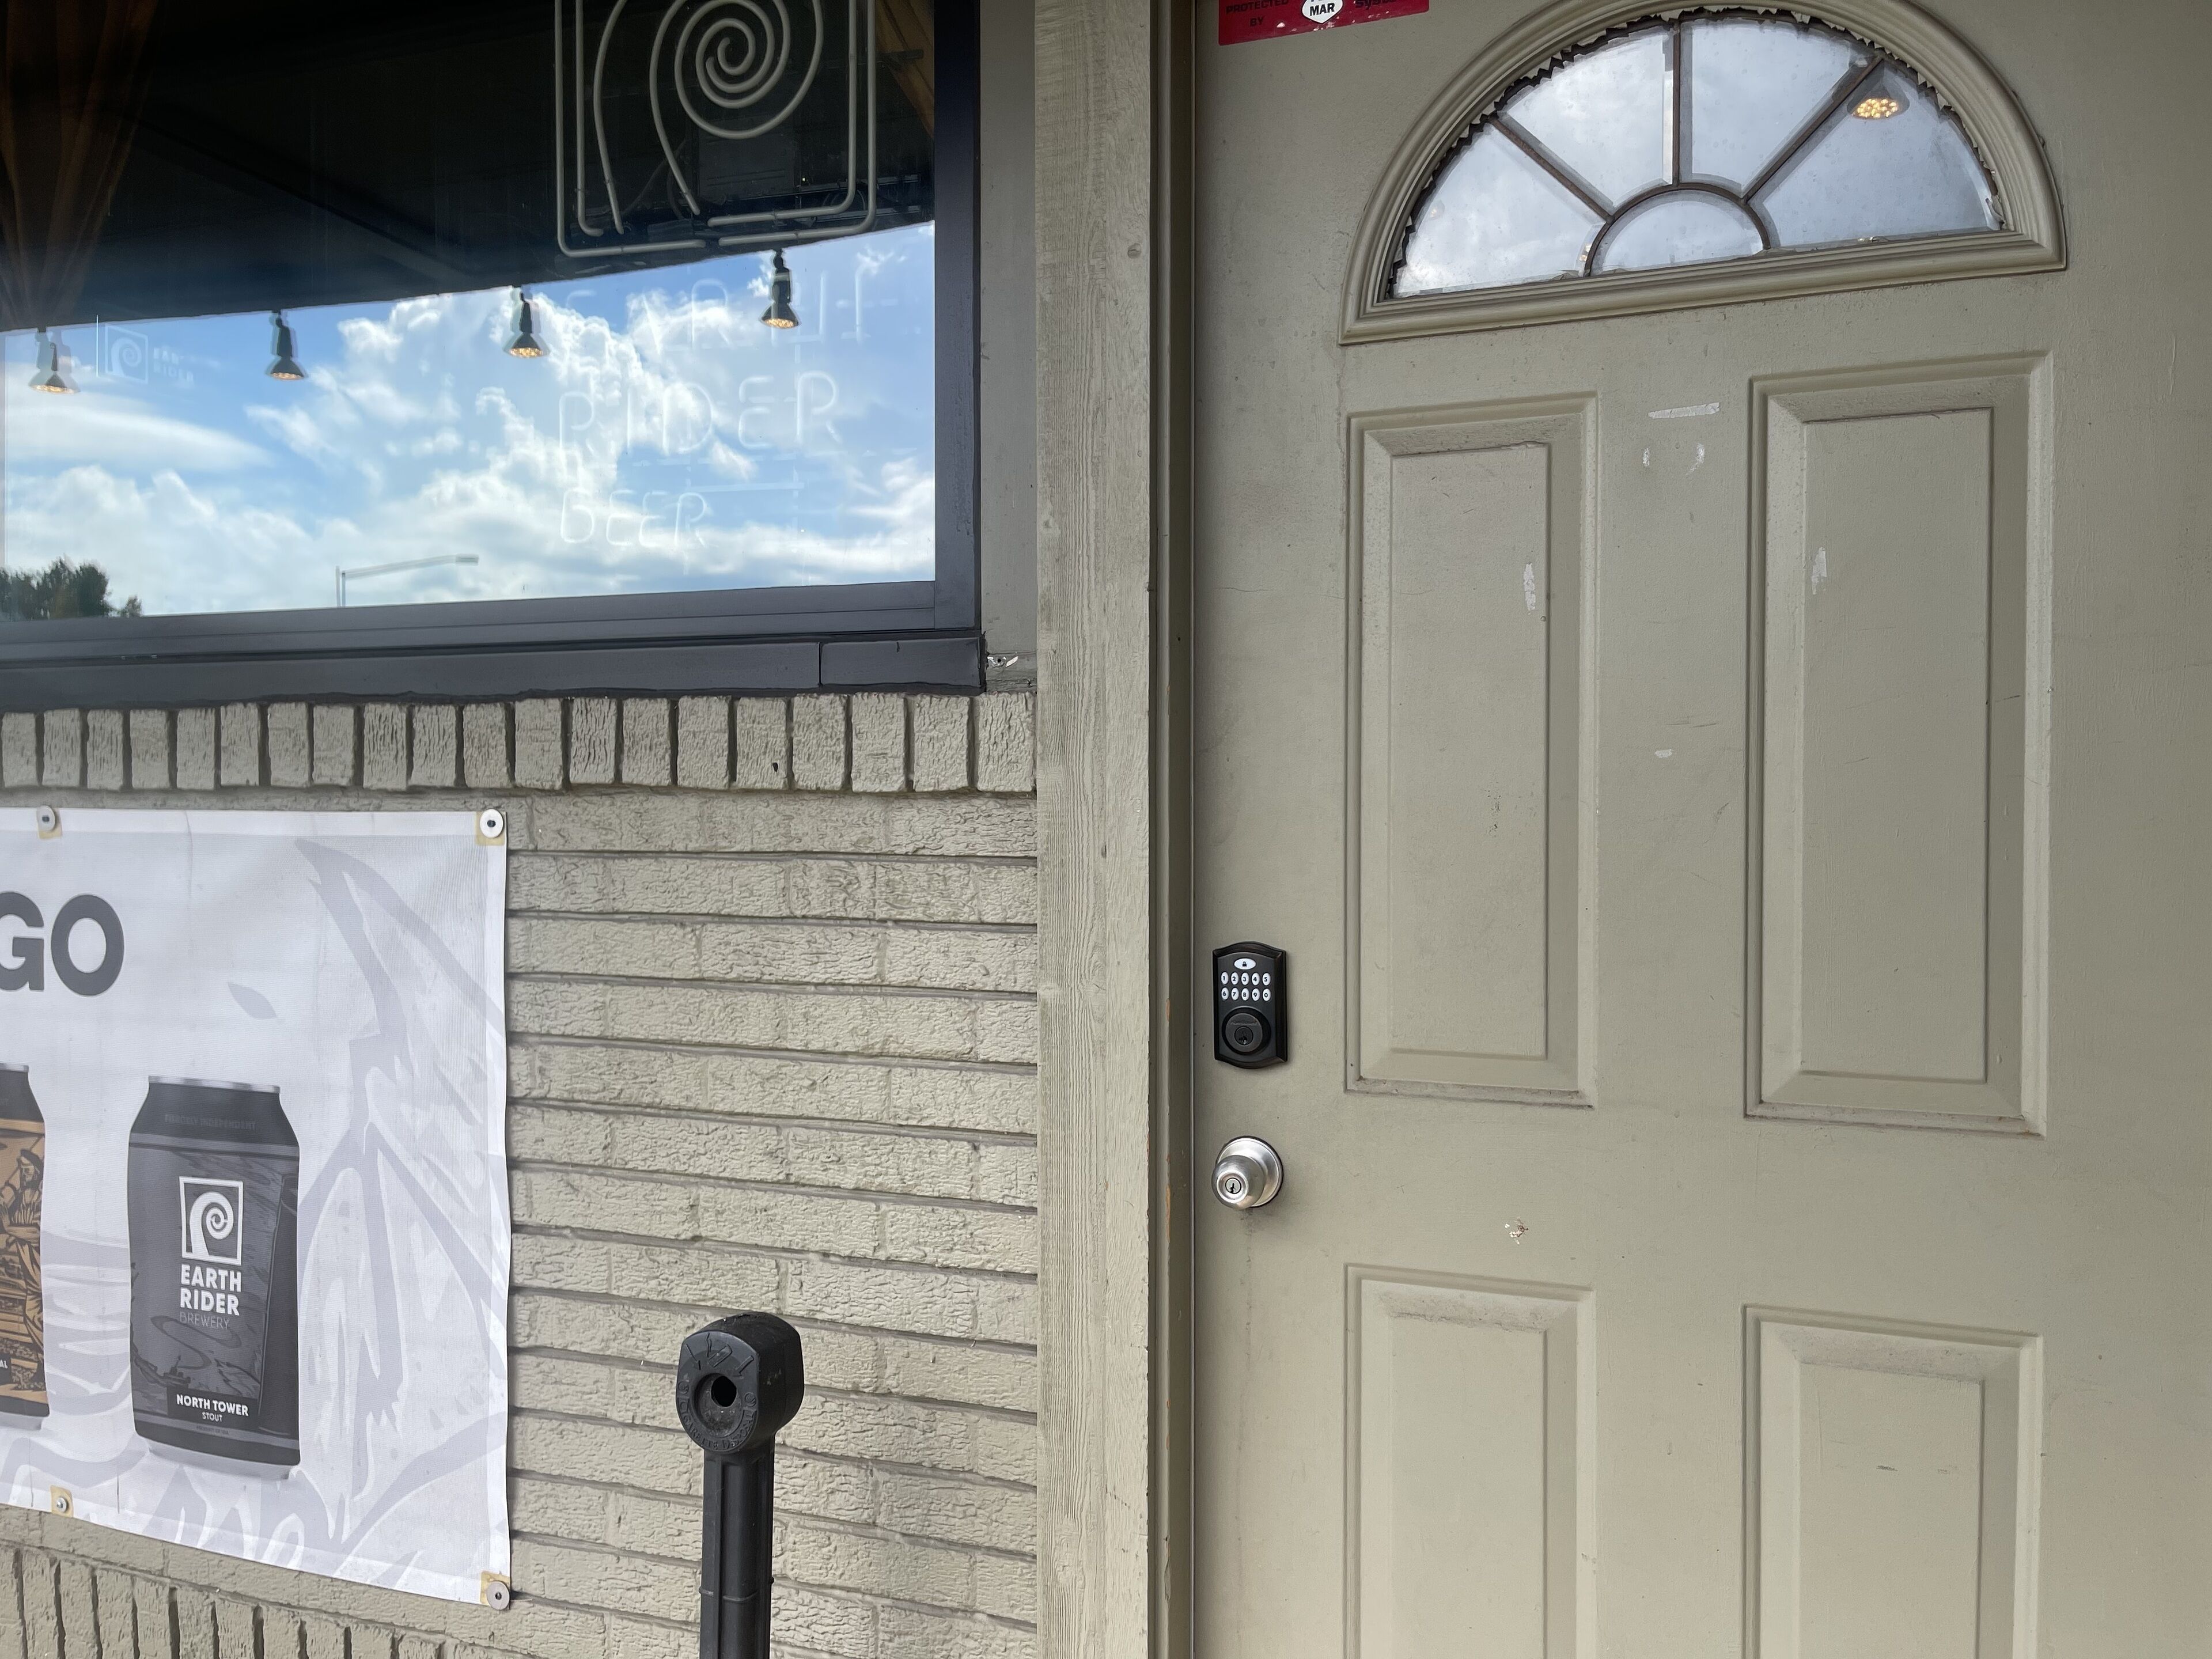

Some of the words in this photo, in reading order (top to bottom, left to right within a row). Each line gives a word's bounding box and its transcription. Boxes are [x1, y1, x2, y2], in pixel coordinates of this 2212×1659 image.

[1310, 3, 1335, 16] MAR
[1250, 17, 1264, 26] BY
[559, 370, 843, 455] RIDER
[0, 891, 124, 997] GO
[181, 1264, 241, 1292] EARTH
[180, 1287, 240, 1316] RIDER
[180, 1311, 230, 1330] BREWERY
[176, 1394, 210, 1410] NORTH
[212, 1400, 249, 1416] TOWER
[202, 1411, 222, 1422] STOUT
